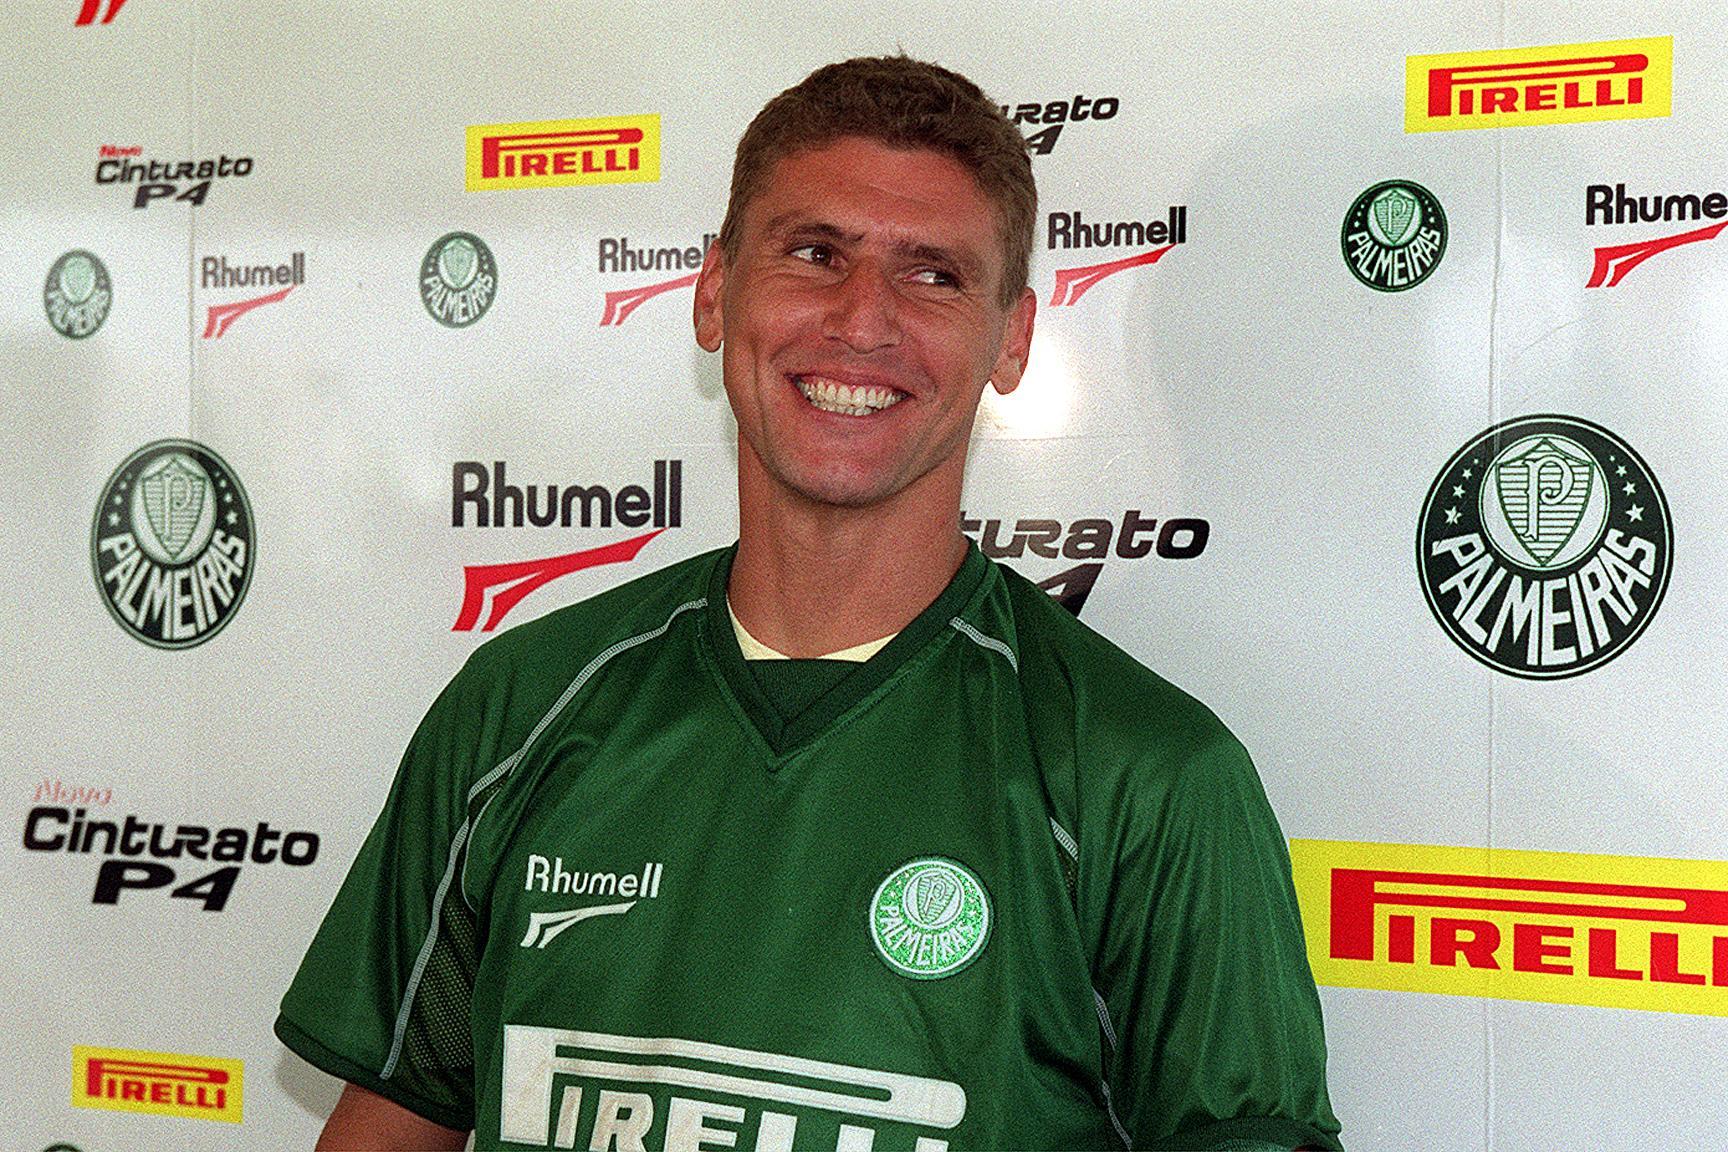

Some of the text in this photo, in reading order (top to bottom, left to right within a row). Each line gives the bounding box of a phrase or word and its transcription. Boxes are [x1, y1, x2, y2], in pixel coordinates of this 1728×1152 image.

[1428, 54, 1648, 117] PIRELLI
[482, 128, 643, 178] PIRELLI
[1026, 125, 1063, 155] 4
[95, 155, 253, 185] Cinturato
[133, 181, 211, 209] P4
[1048, 206, 1187, 249] Rhumell
[1586, 184, 1728, 225] Rhume
[202, 252, 304, 288] Rhumell
[599, 233, 718, 273] Rhumel
[1348, 226, 1441, 286] PALMEIRAS
[424, 272, 494, 323] PALMEIRAS
[452, 460, 682, 528] Rhumell
[960, 510, 1210, 560] urato
[99, 528, 246, 640] PALMEIRAS
[1036, 563, 1104, 617] 4
[1431, 527, 1657, 666] PALMEIRAS
[23, 807, 320, 866] Cinturato
[92, 860, 241, 912] P4
[525, 854, 663, 898] Rhumell
[880, 904, 975, 966] PALMEIRAS
[87, 1058, 229, 1110] PIRELLI
[500, 1025, 966, 1152] PIRE
